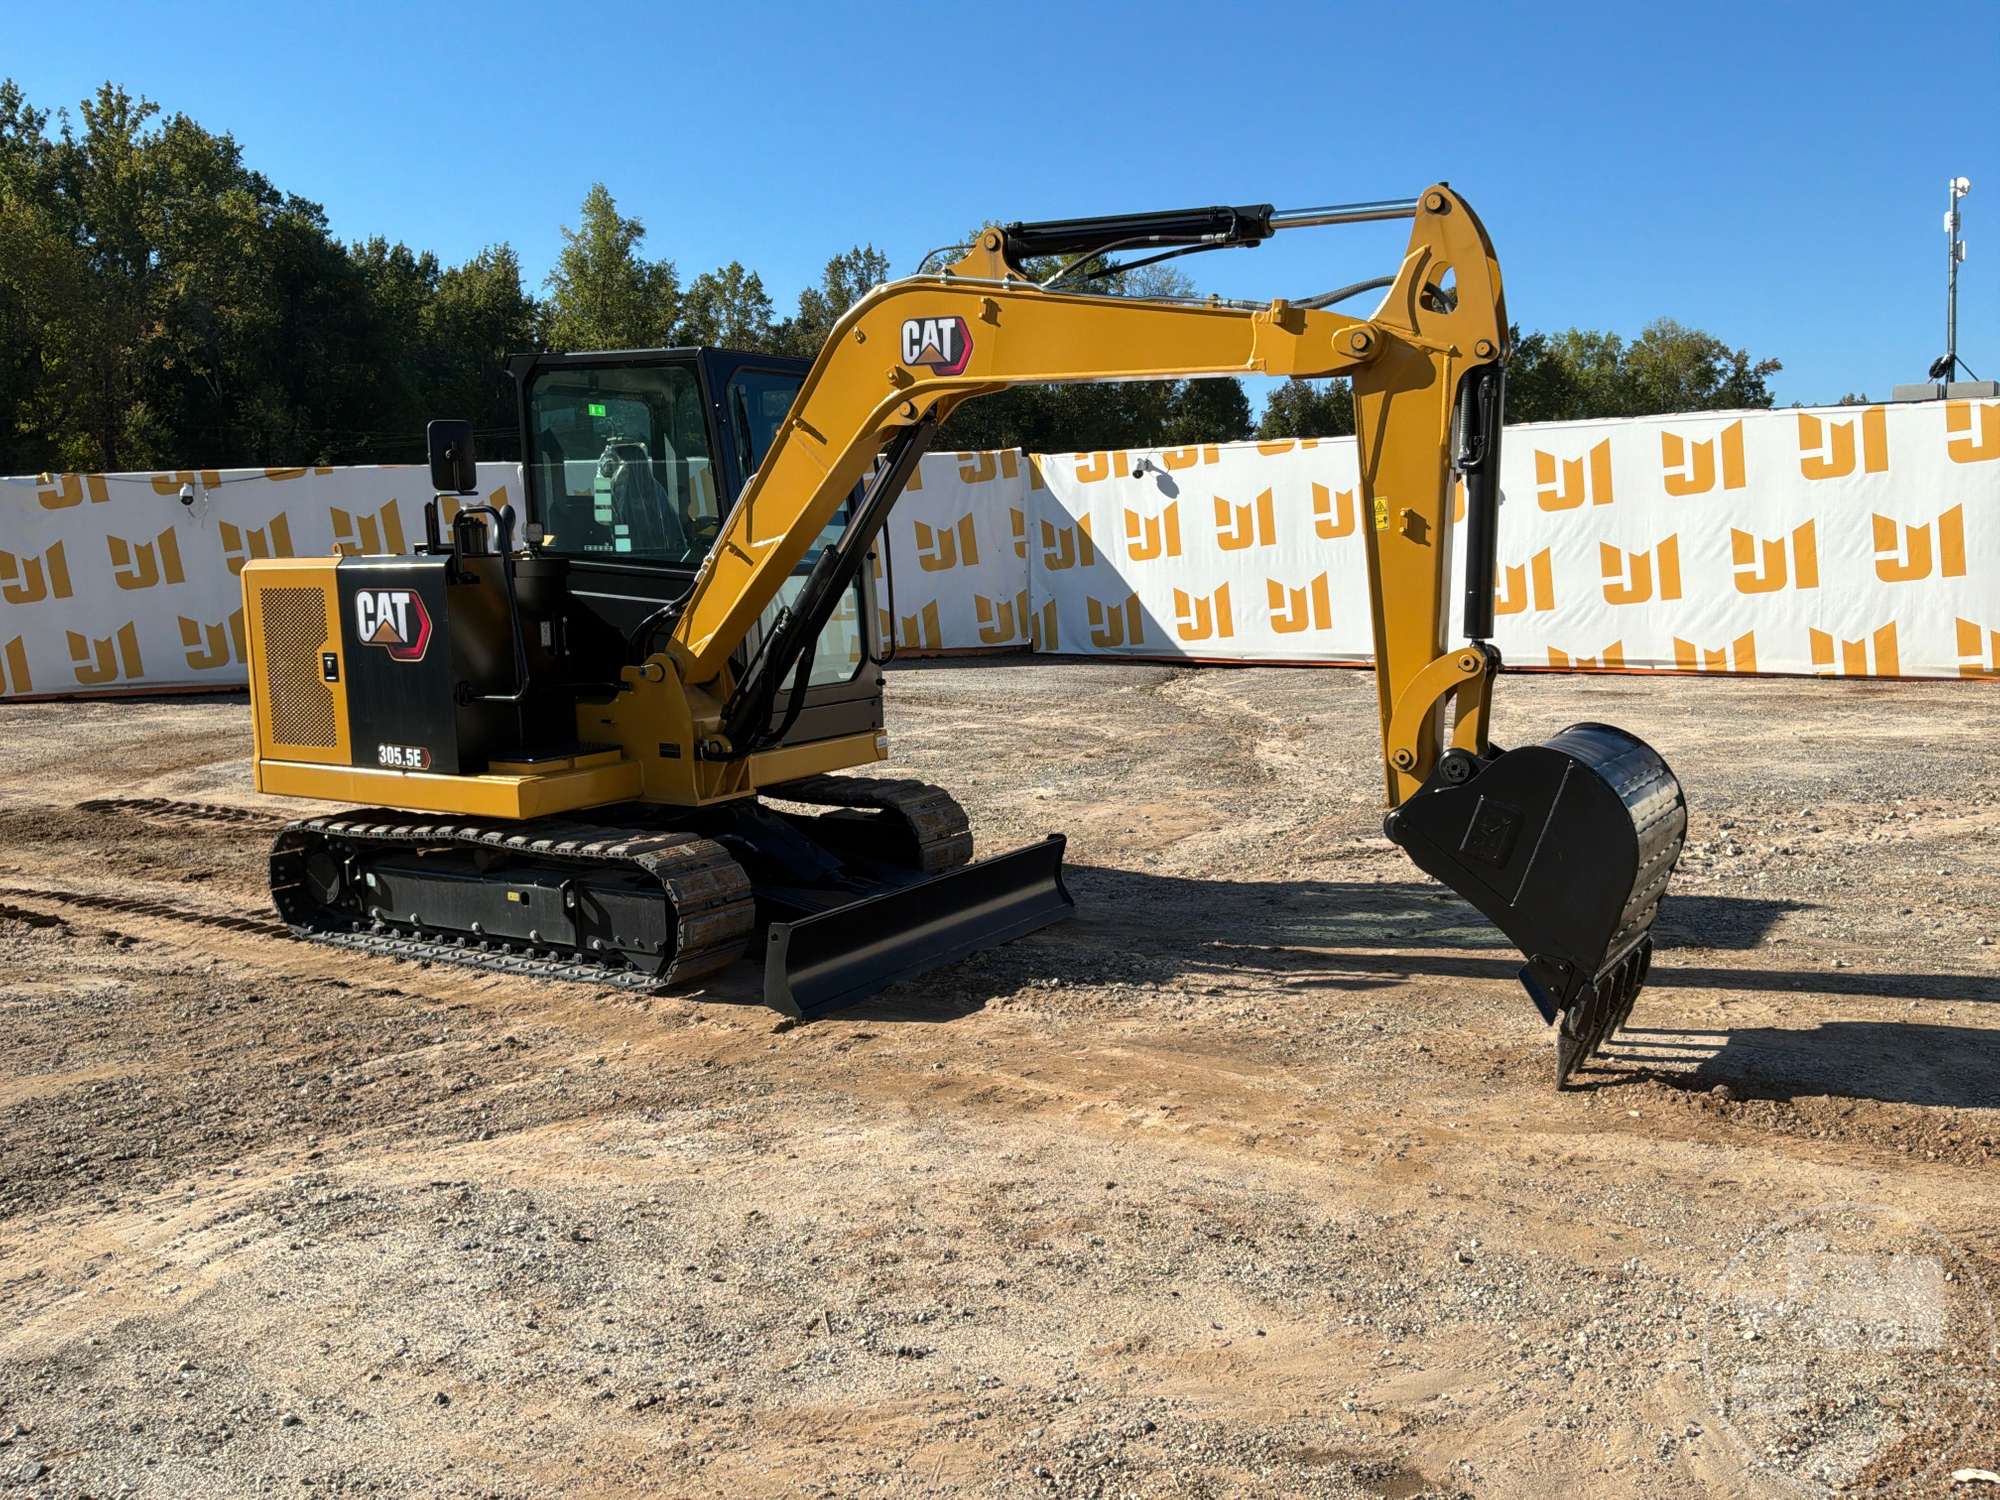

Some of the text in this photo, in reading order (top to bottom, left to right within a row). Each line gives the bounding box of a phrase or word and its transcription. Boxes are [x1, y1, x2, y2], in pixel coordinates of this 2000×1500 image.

[902, 318, 956, 365] CAT
[357, 591, 410, 643] CAT
[378, 744, 422, 767] 305.5E
